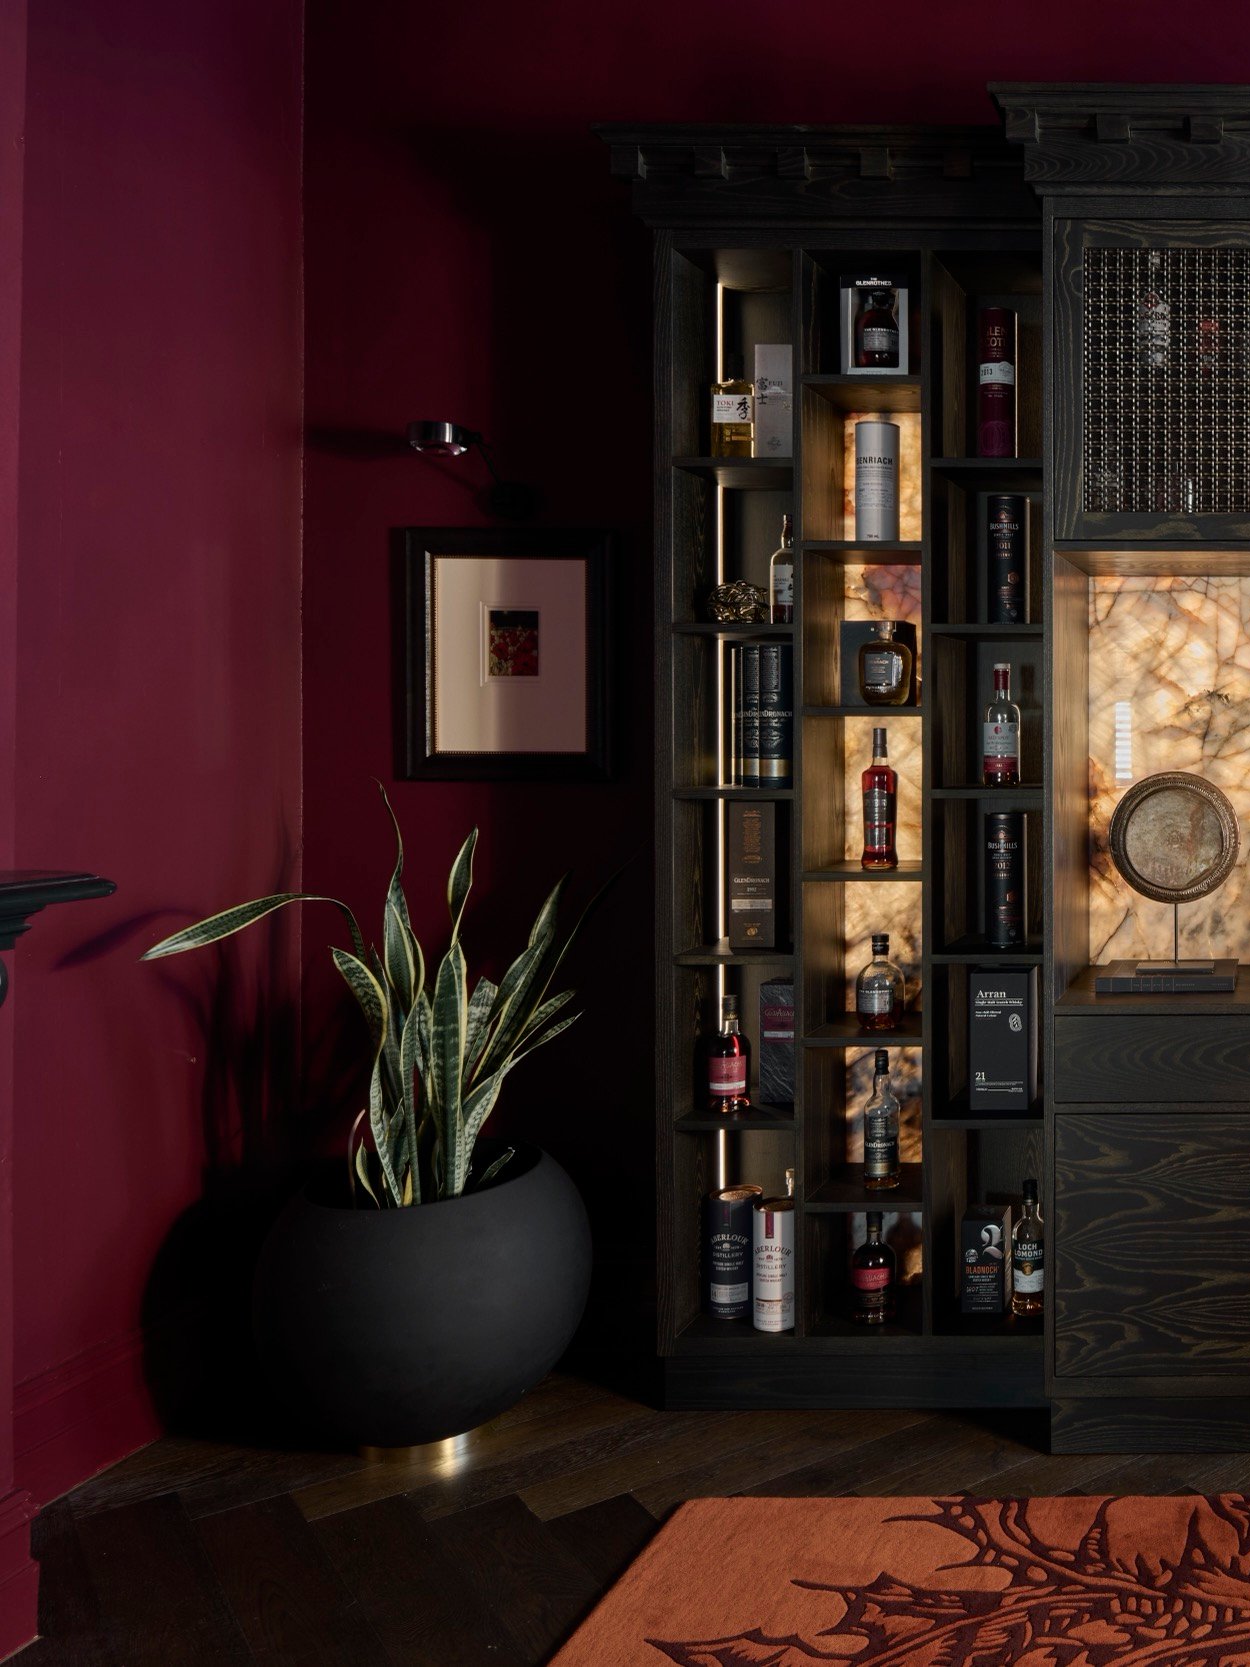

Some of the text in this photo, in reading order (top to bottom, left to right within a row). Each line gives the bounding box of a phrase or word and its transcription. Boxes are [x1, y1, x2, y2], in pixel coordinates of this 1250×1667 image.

[989, 522, 1019, 531] BUSHMILLS
[976, 989, 1007, 999] Arran
[975, 1071, 986, 1080] 21
[711, 1233, 749, 1246] ABERLOUR
[754, 1246, 792, 1257] ABERLOUR
[1018, 1243, 1038, 1251] LOCH
[1015, 1249, 1043, 1257] LOMOND
[756, 1263, 787, 1271] DISTILLERY
[965, 1265, 998, 1274] BLADNOCH
